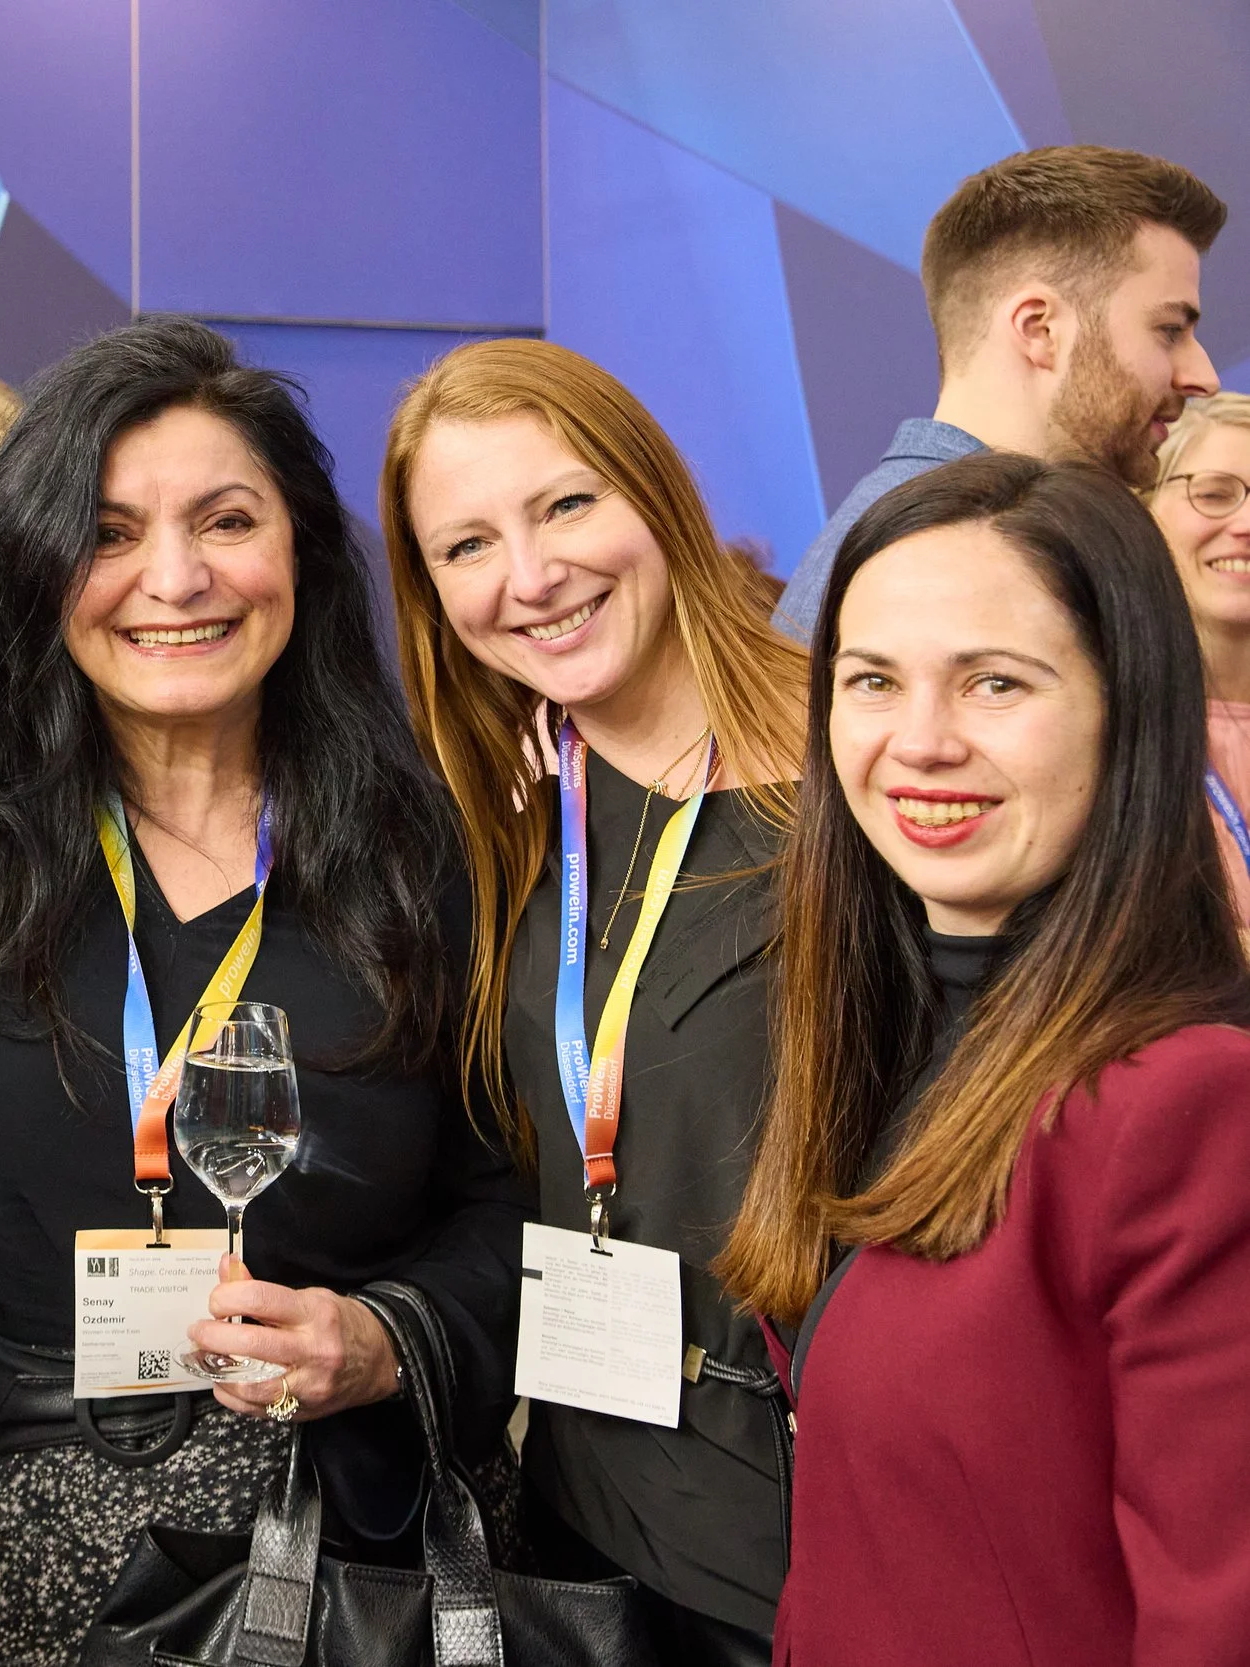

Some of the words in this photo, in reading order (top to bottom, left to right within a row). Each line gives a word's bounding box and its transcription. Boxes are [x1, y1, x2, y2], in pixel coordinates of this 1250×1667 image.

[562, 741, 572, 791] Düsseldorf
[571, 741, 586, 789] ProSpirits
[566, 853, 585, 966] prowein.com
[218, 914, 261, 1000] prowein.
[561, 1042, 582, 1104] Düsseldorf
[589, 1057, 607, 1119] ProWein
[604, 1060, 619, 1120] Düsseldorf
[82, 1297, 114, 1308] Senay
[158, 1285, 188, 1293] VISITOR
[82, 1315, 125, 1325] Ozdemir
